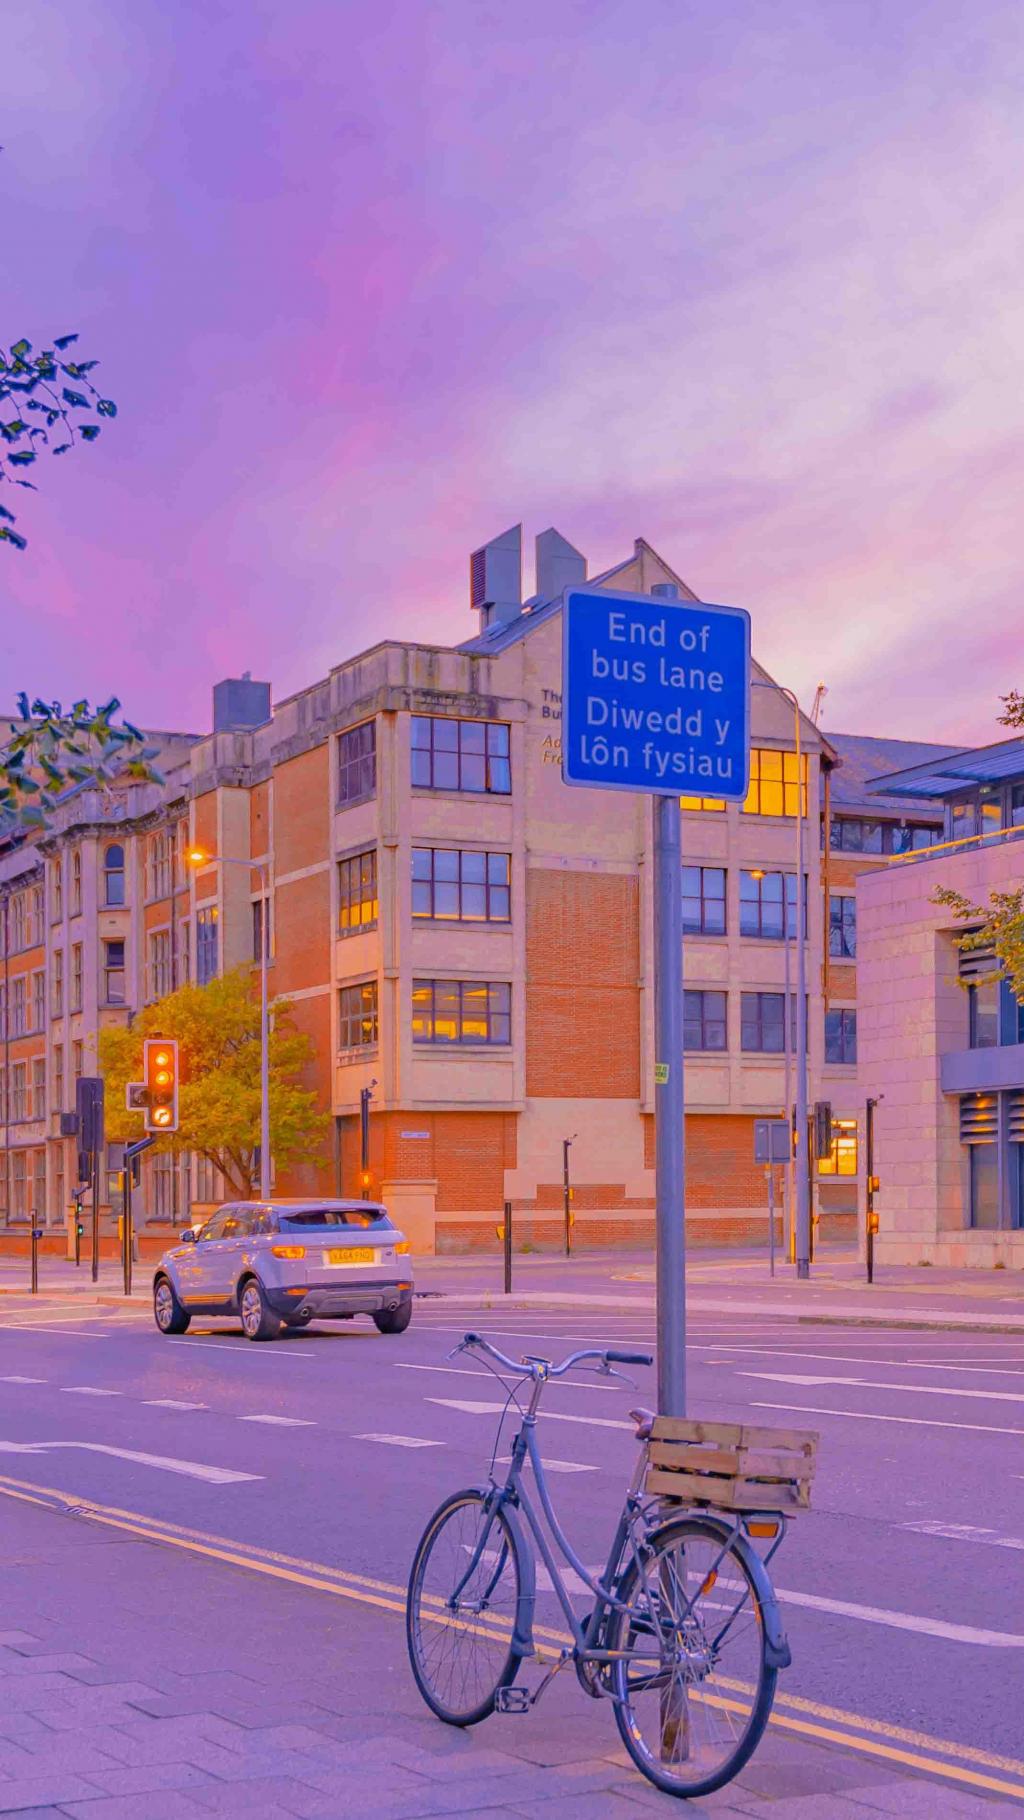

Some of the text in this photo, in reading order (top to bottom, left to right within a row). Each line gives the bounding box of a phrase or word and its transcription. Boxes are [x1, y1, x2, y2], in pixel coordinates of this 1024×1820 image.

[609, 612, 711, 652] End of
[592, 649, 724, 692] bus lane
[587, 696, 730, 745] Diwedd y
[581, 735, 732, 778] lôn fysiau
